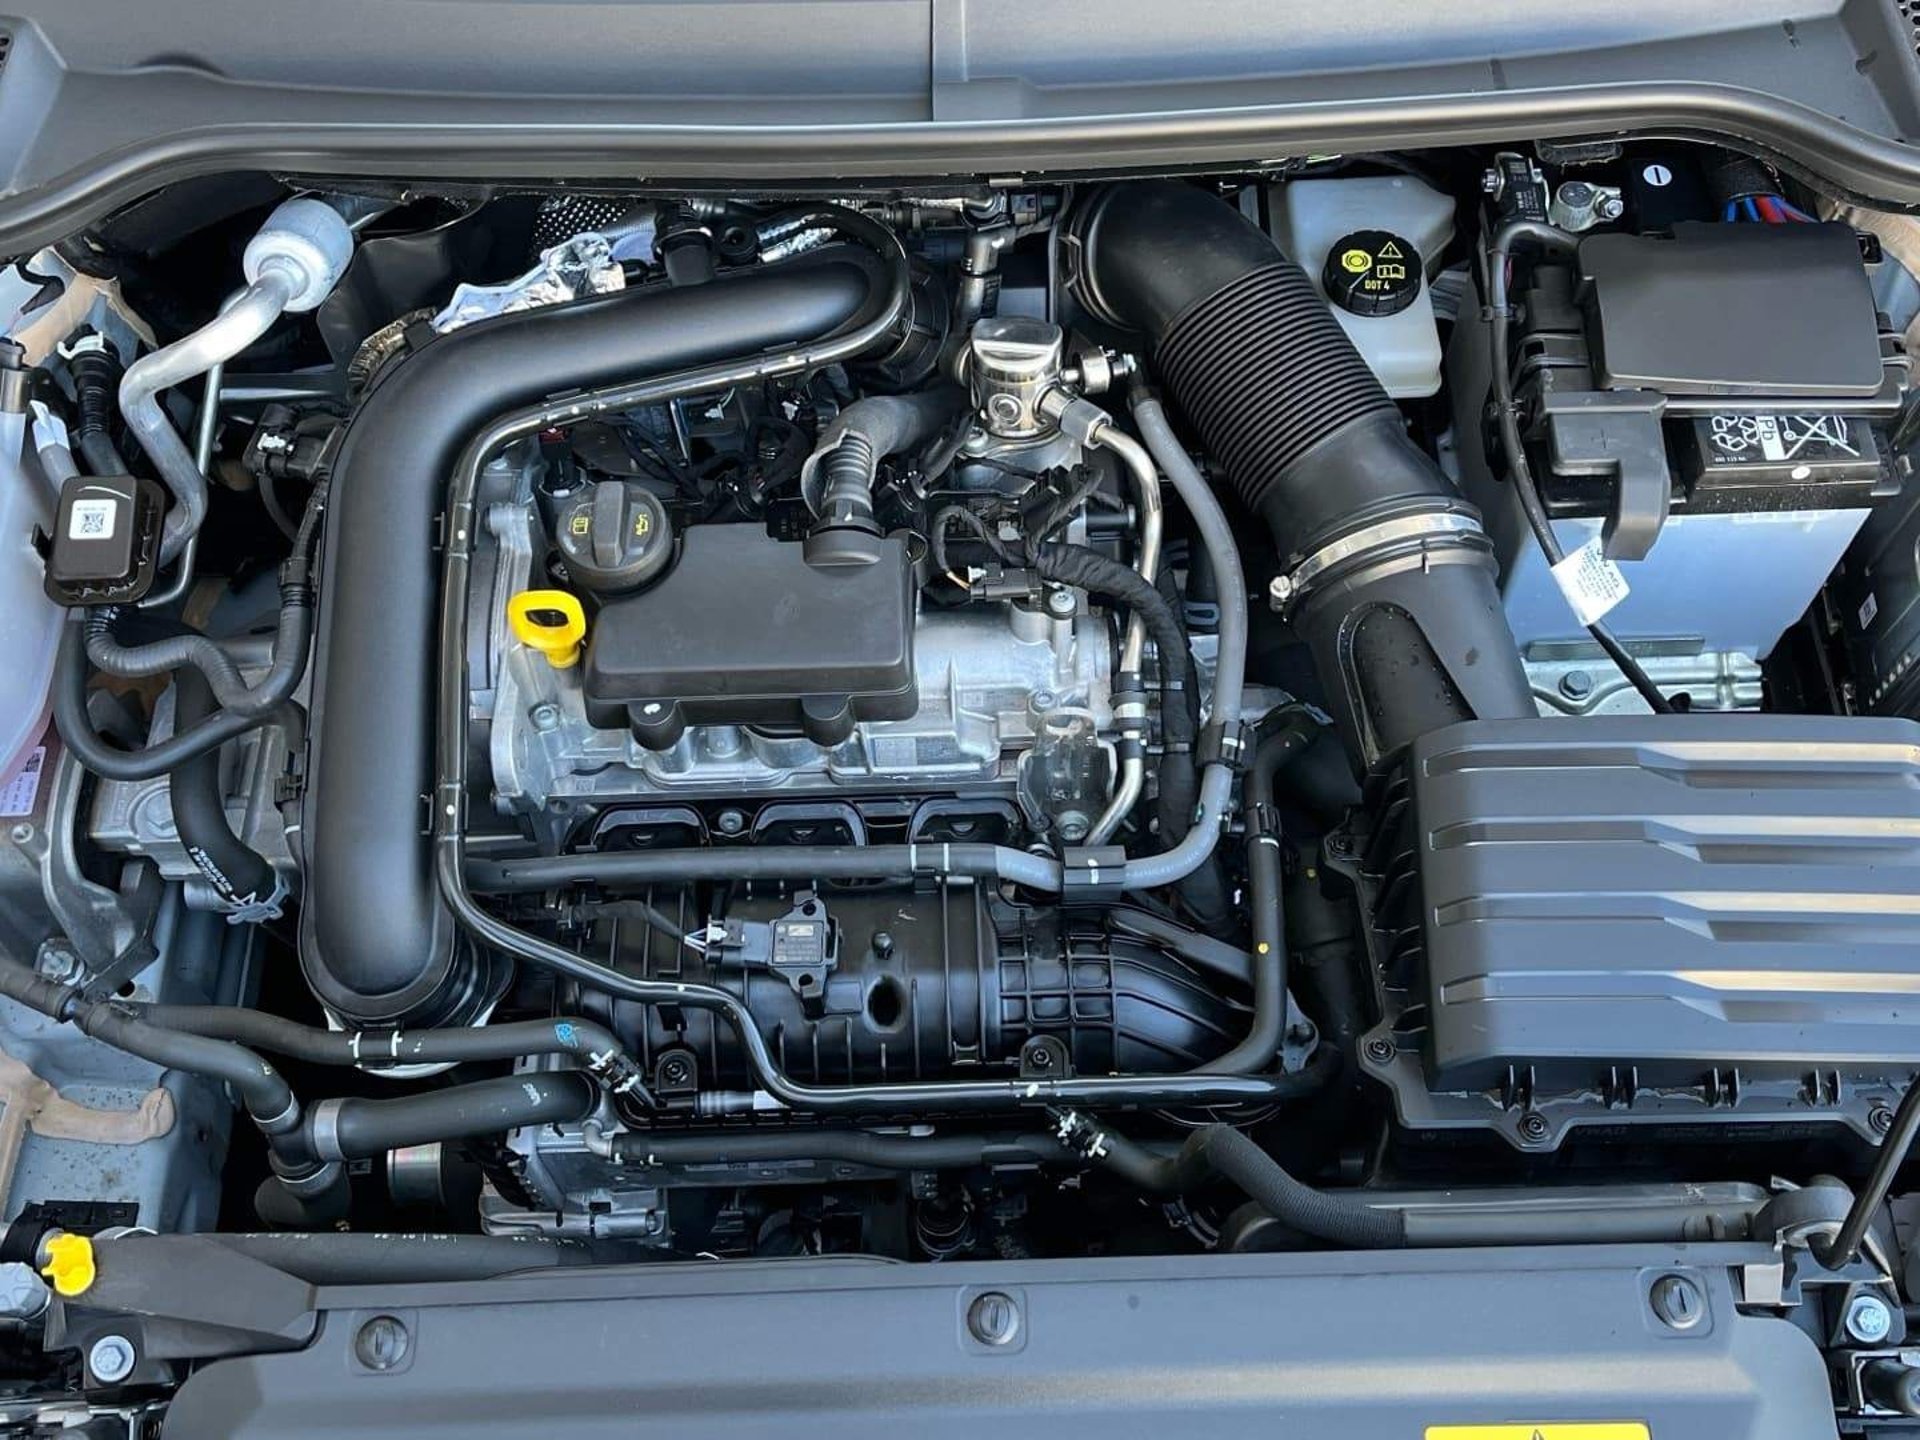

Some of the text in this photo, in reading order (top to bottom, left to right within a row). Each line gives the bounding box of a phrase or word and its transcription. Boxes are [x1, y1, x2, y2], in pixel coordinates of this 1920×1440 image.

[1365, 279, 1390, 290] DOT 4
[1759, 419, 1776, 441] Pb
